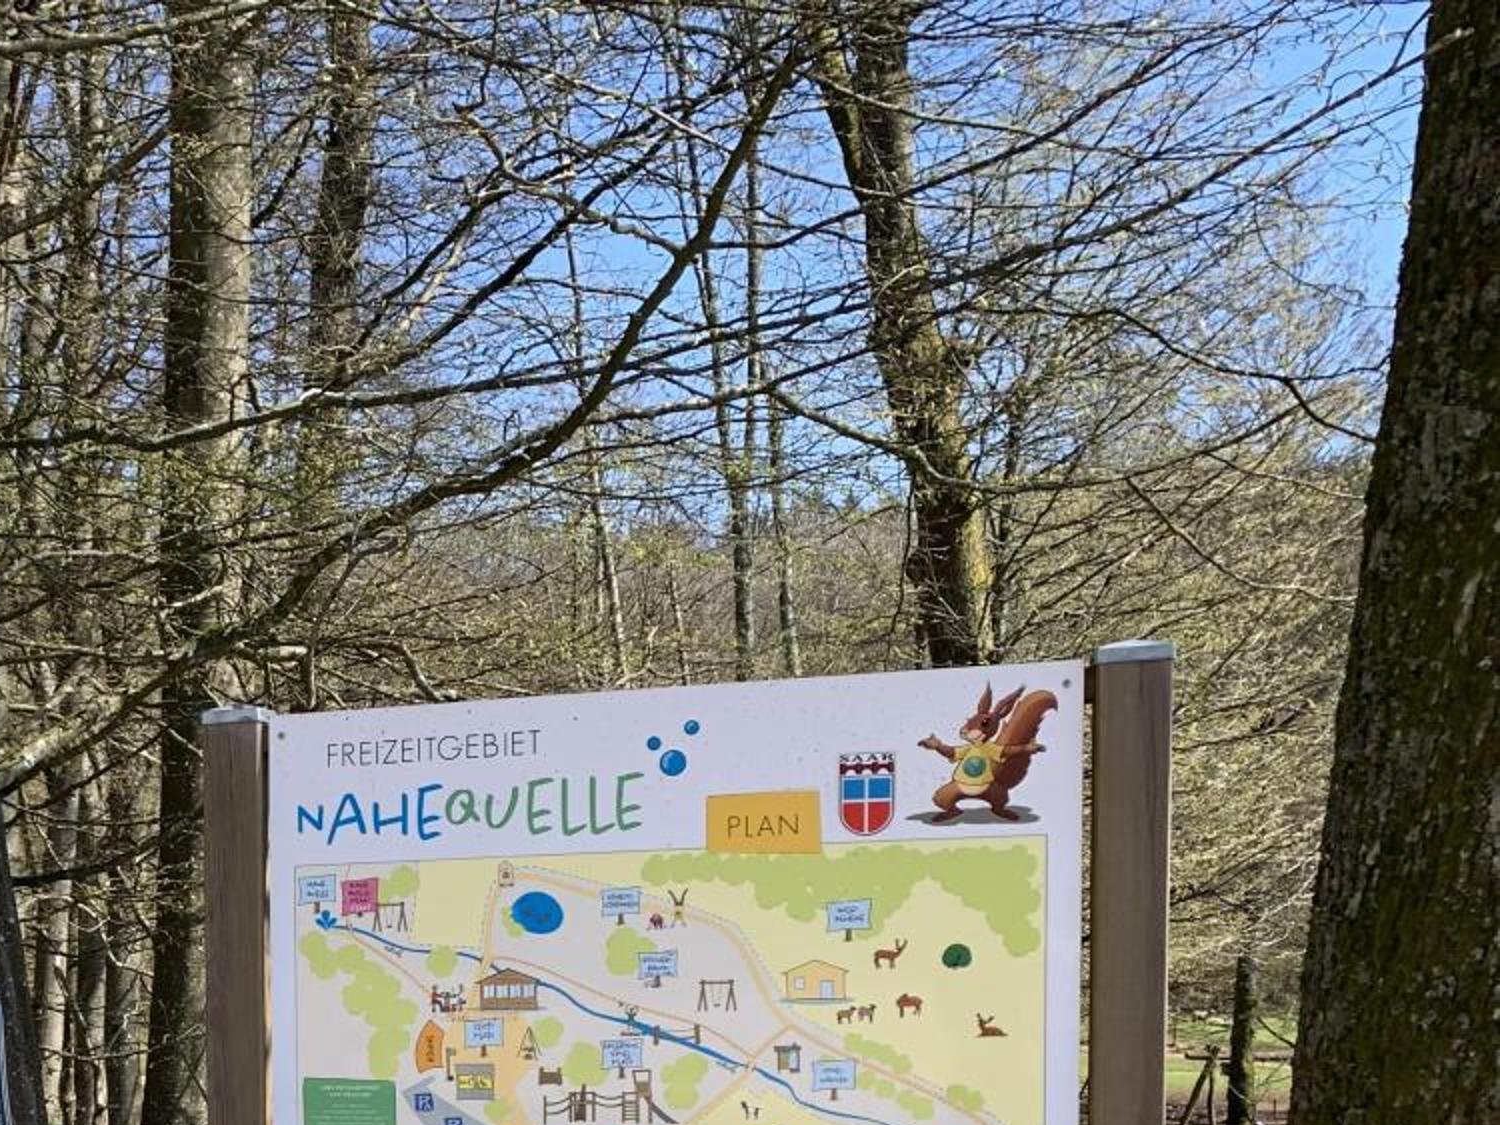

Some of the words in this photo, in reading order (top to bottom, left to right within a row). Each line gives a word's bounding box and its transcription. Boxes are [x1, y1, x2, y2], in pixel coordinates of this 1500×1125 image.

[326, 729, 542, 768] FREIZEITGEBIET
[839, 752, 895, 763] SAAR
[296, 772, 645, 846] NAHEQUELLE
[726, 813, 801, 839] PLAN
